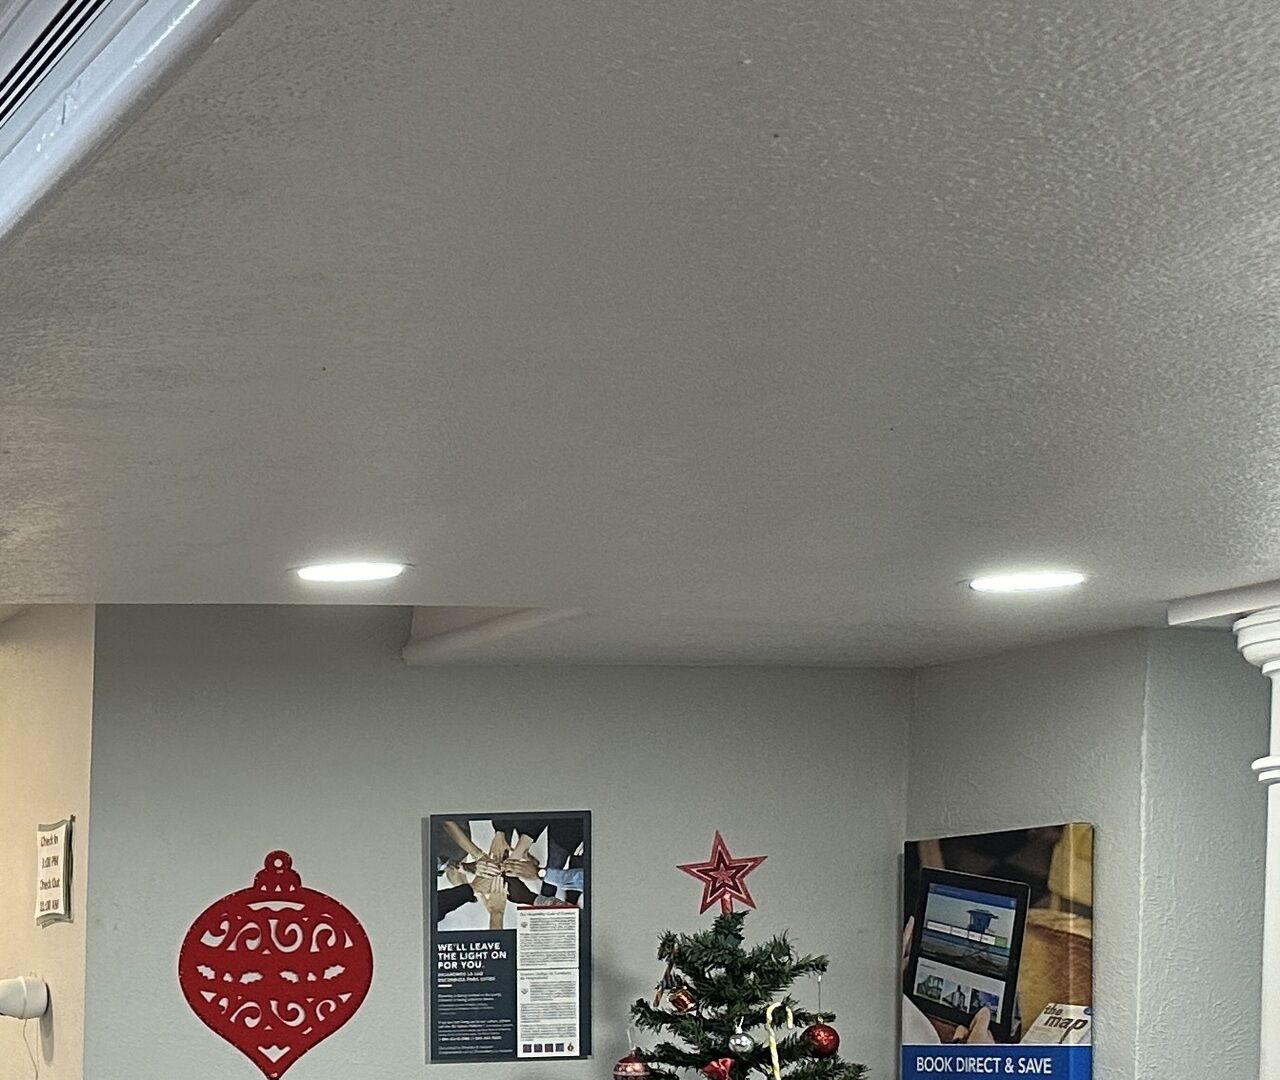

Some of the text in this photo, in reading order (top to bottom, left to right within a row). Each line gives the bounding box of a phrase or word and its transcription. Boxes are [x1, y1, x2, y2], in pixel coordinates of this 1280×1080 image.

[437, 942, 501, 952] WE'LL LEAVE
[437, 950, 507, 961] THE LIGHT ON
[1043, 1003, 1064, 1016] the
[1043, 1016, 1089, 1043] map
[916, 1056, 1053, 1075] BOOK DIRECT & SAVE
